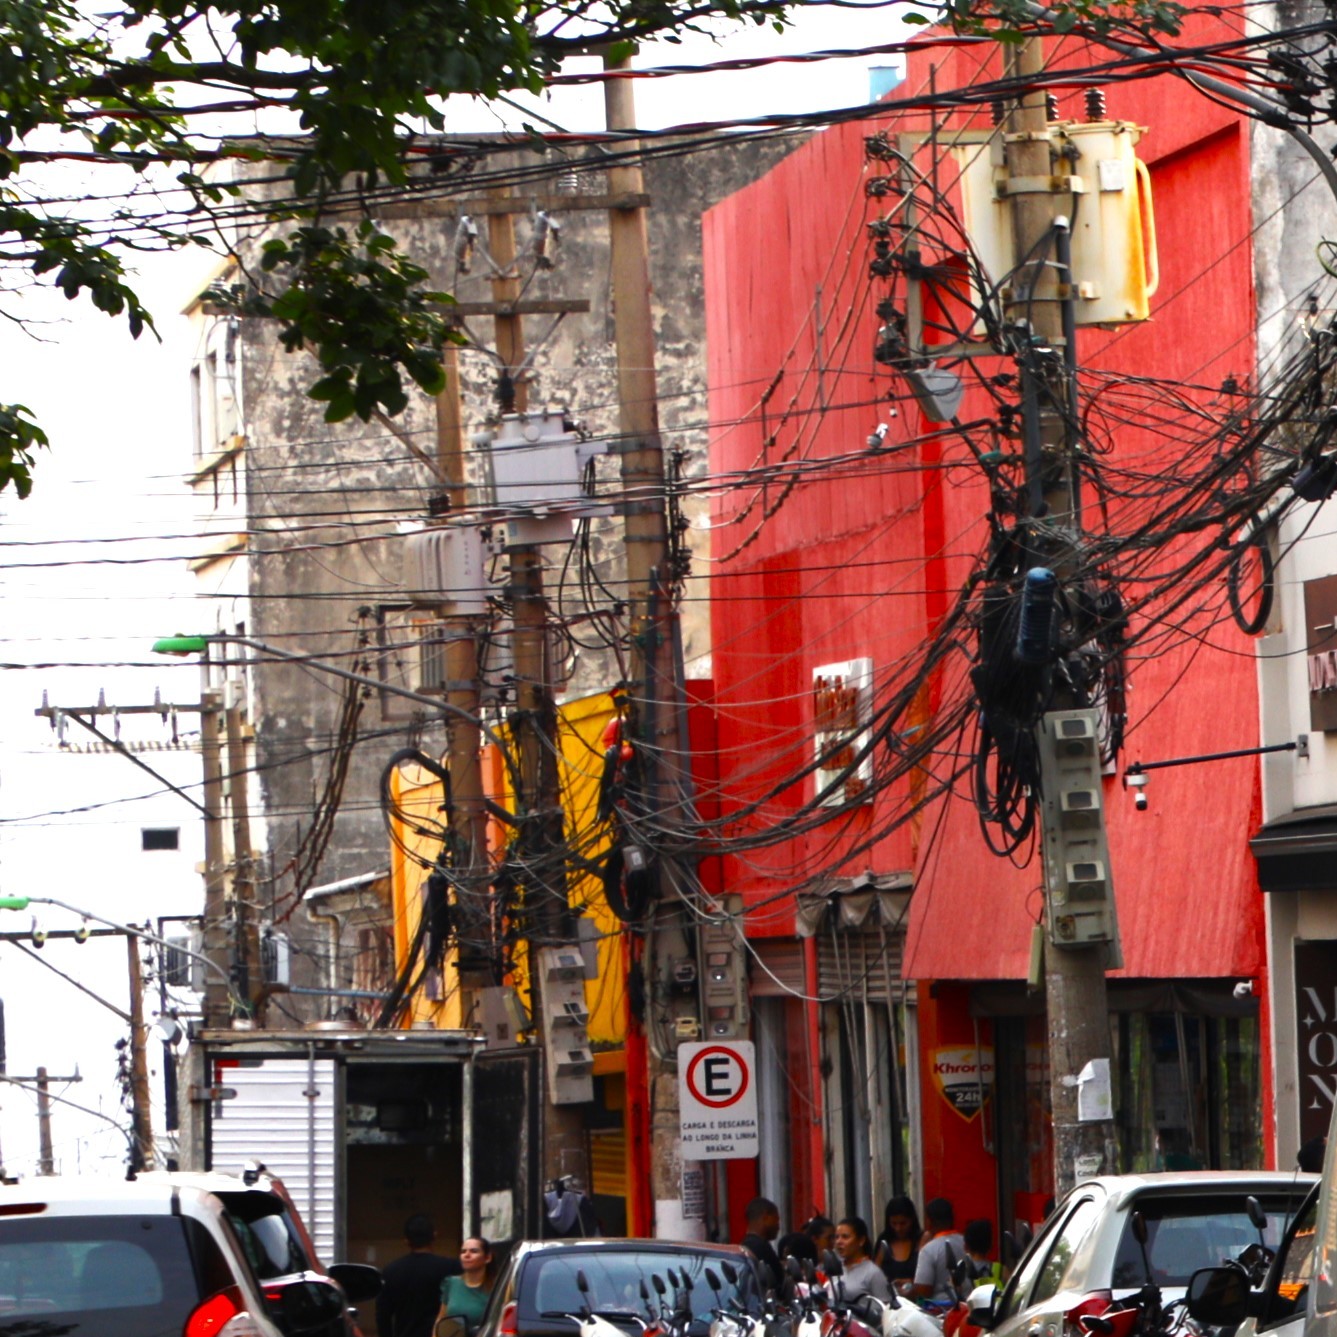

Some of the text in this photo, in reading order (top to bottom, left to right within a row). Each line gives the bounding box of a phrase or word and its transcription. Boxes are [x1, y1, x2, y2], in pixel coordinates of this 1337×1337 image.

[704, 1057, 732, 1096] E
[682, 1120, 755, 1130] CARGA E DESCARGA
[696, 1134, 719, 1142] LONGO
[735, 1132, 757, 1140] LINHA
[705, 1145, 735, 1153] BRANCA
